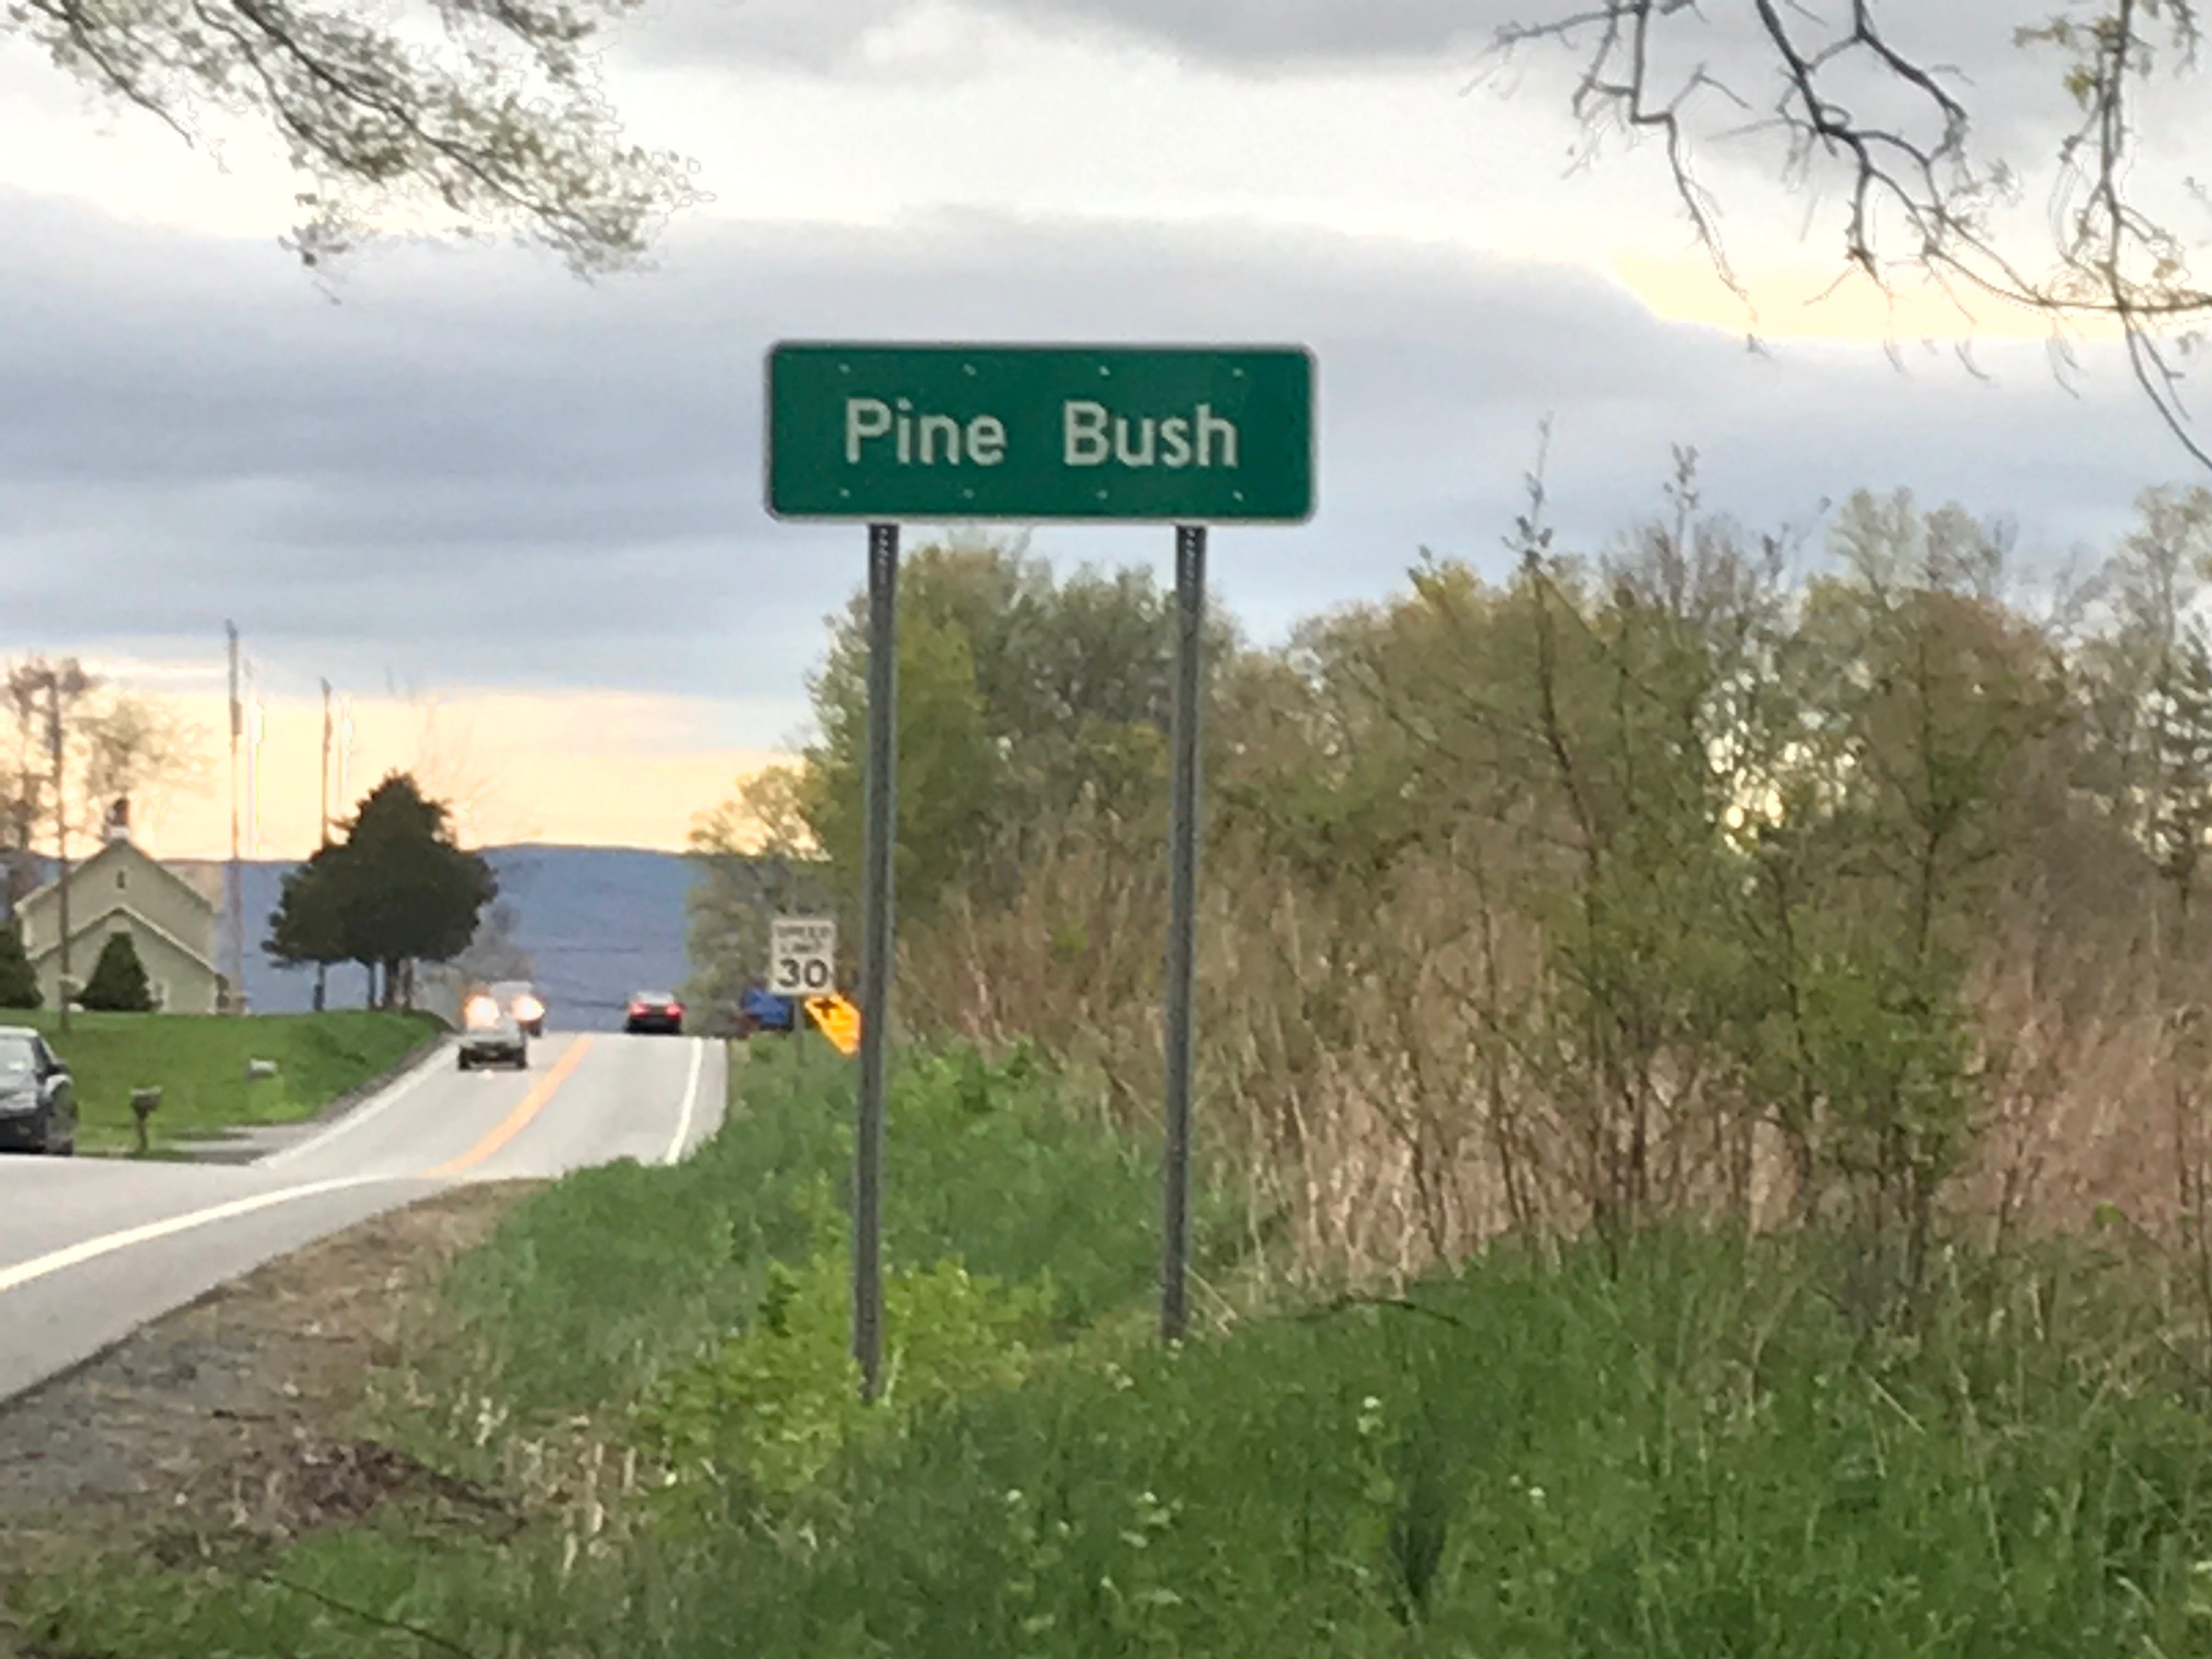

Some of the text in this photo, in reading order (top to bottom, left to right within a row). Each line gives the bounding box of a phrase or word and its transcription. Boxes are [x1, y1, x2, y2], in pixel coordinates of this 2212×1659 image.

[845, 397, 1238, 467] Pine Bush
[778, 958, 828, 988] 30
